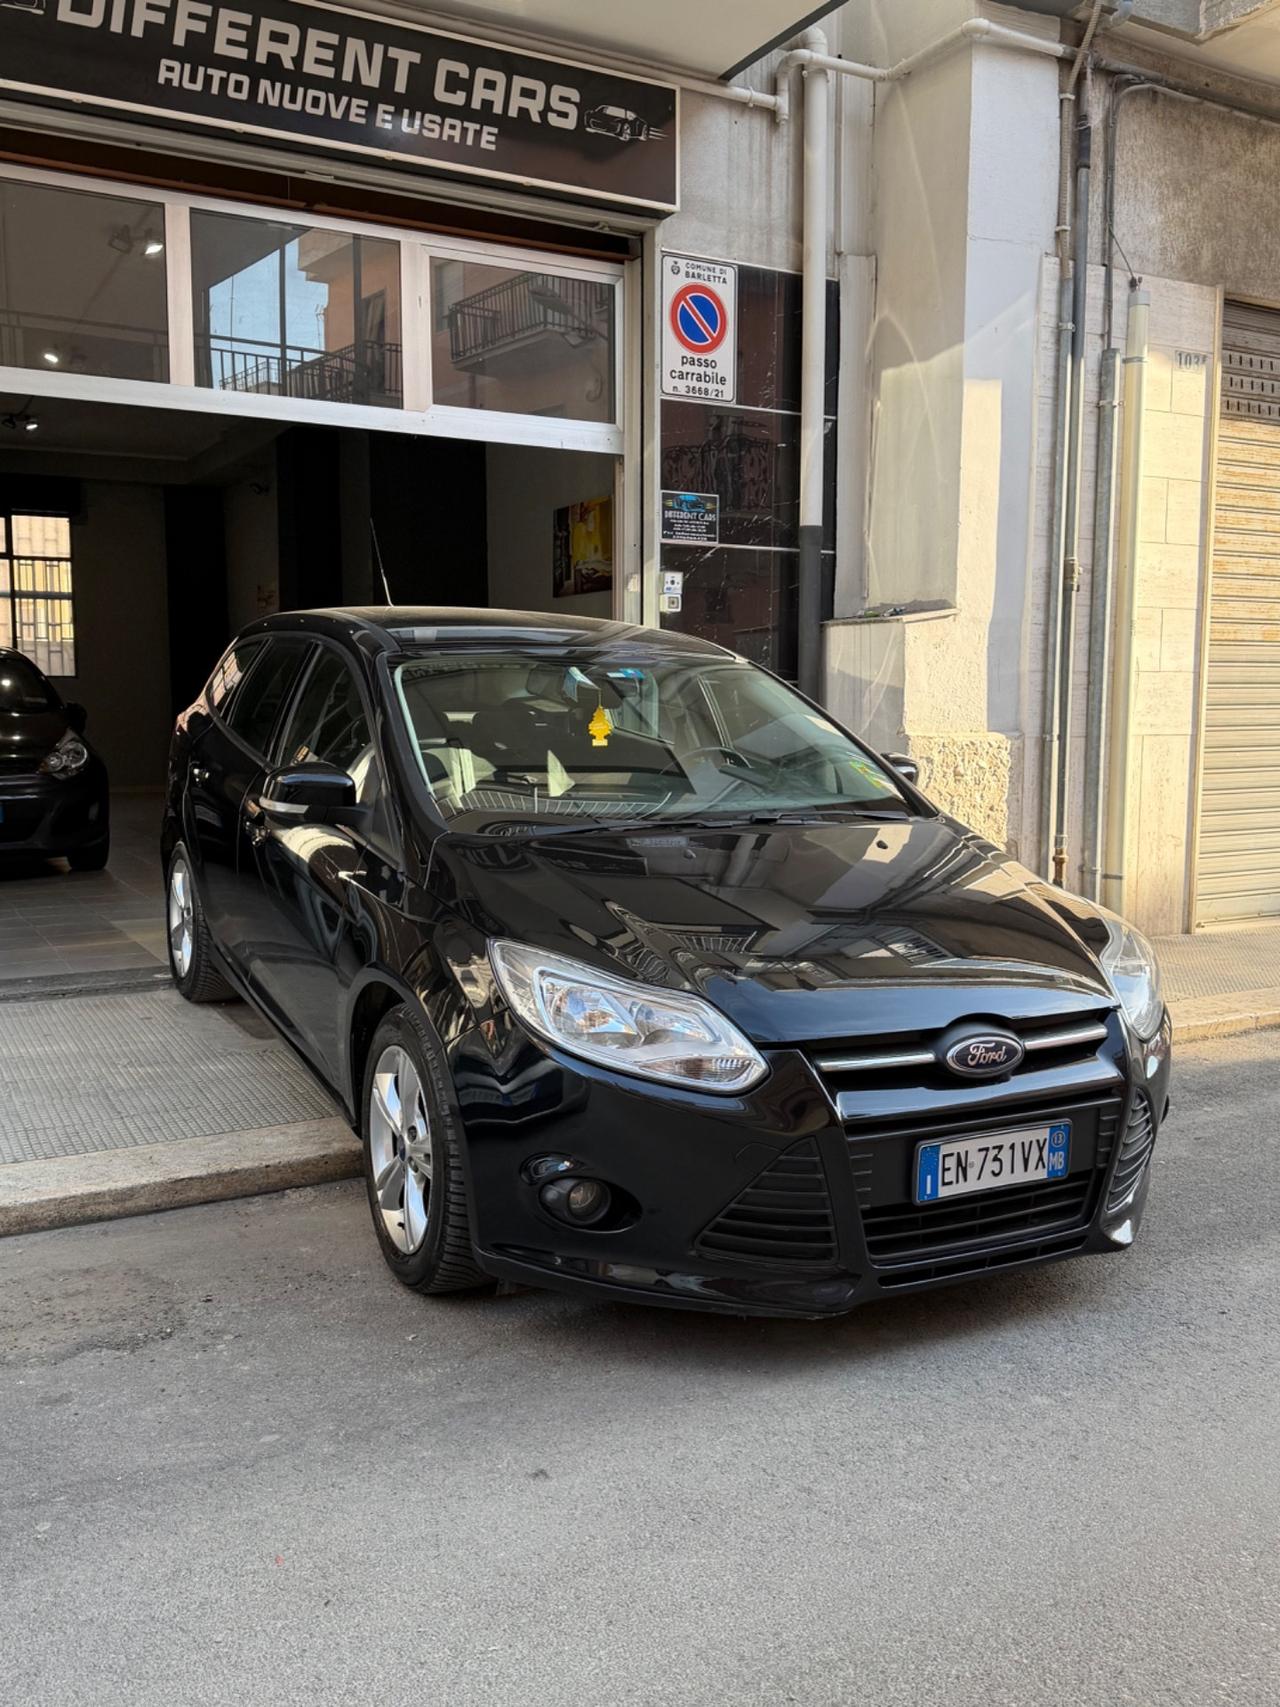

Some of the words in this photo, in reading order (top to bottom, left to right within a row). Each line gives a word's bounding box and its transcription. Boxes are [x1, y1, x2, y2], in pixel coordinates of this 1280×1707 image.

[56, 0, 422, 94] DIFFERENT
[433, 58, 581, 130] CARS
[157, 58, 250, 101] AUTO
[257, 79, 369, 124] NUOVE
[375, 103, 395, 130] E
[401, 108, 499, 151] USATE
[685, 262, 716, 273] COMUNE
[685, 270, 727, 284] BARLETTA
[681, 355, 717, 369] passo
[670, 369, 727, 385] carrabile
[672, 385, 682, 393] n.
[684, 384, 724, 398] 3668/21
[967, 1042, 1007, 1066] Ford
[1054, 1133, 1063, 1145] 13
[1049, 1151, 1065, 1171] MB
